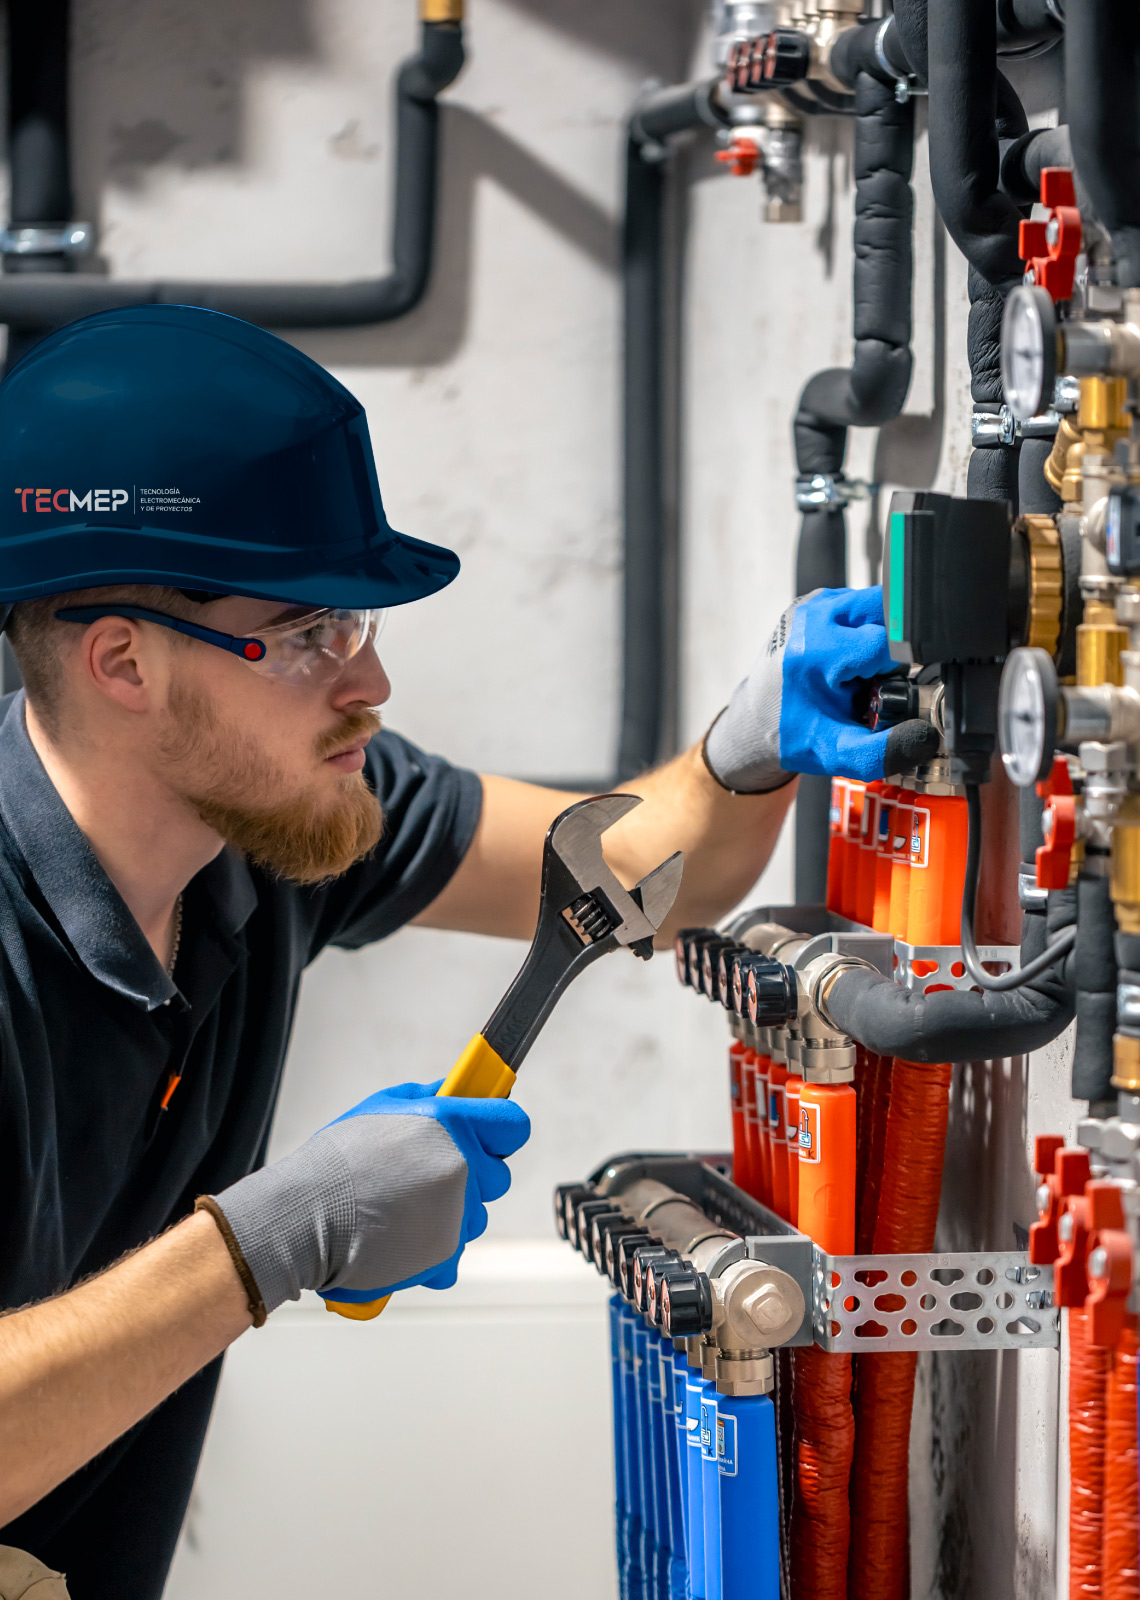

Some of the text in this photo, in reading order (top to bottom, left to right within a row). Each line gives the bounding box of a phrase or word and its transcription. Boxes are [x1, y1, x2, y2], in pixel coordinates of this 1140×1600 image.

[140, 487, 180, 495] TECNOLOGÍA
[14, 488, 129, 512] TECMEP
[140, 496, 201, 504] ELECTROMECÁNICA
